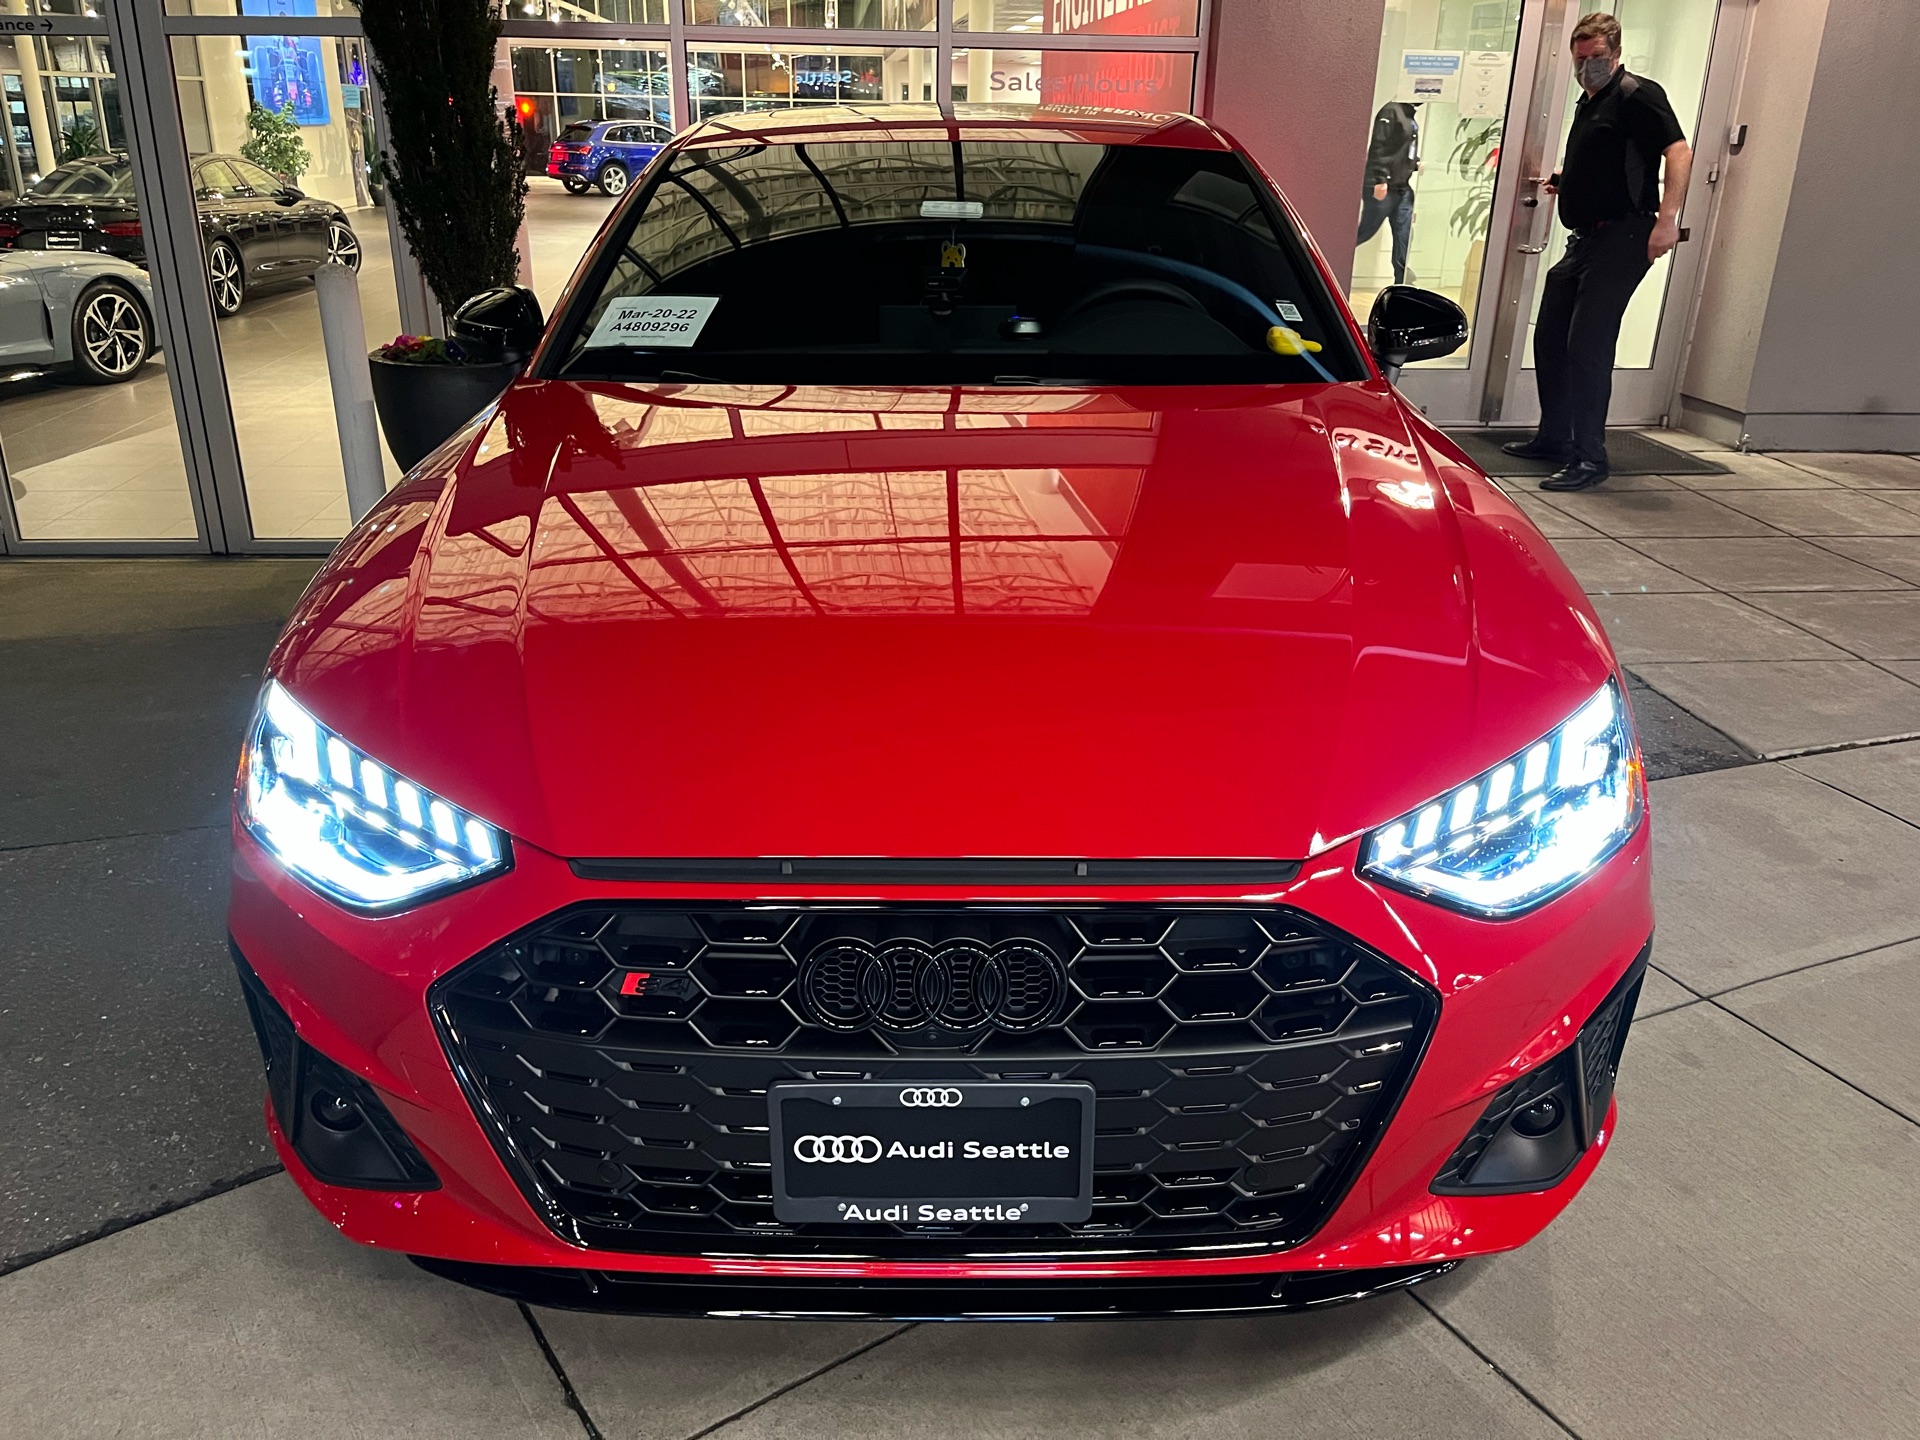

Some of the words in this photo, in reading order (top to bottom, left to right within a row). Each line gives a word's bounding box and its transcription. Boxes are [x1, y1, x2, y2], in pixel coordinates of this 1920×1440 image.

[989, 71, 1065, 93] Sales
[1074, 73, 1158, 95] Hours
[617, 308, 698, 320] Mar-20-22
[609, 321, 690, 332] A4809296
[886, 1141, 954, 1159] Audi
[962, 1141, 1070, 1159] Seattle
[843, 1204, 909, 1221] Audi
[917, 1204, 1022, 1221] Seattle
